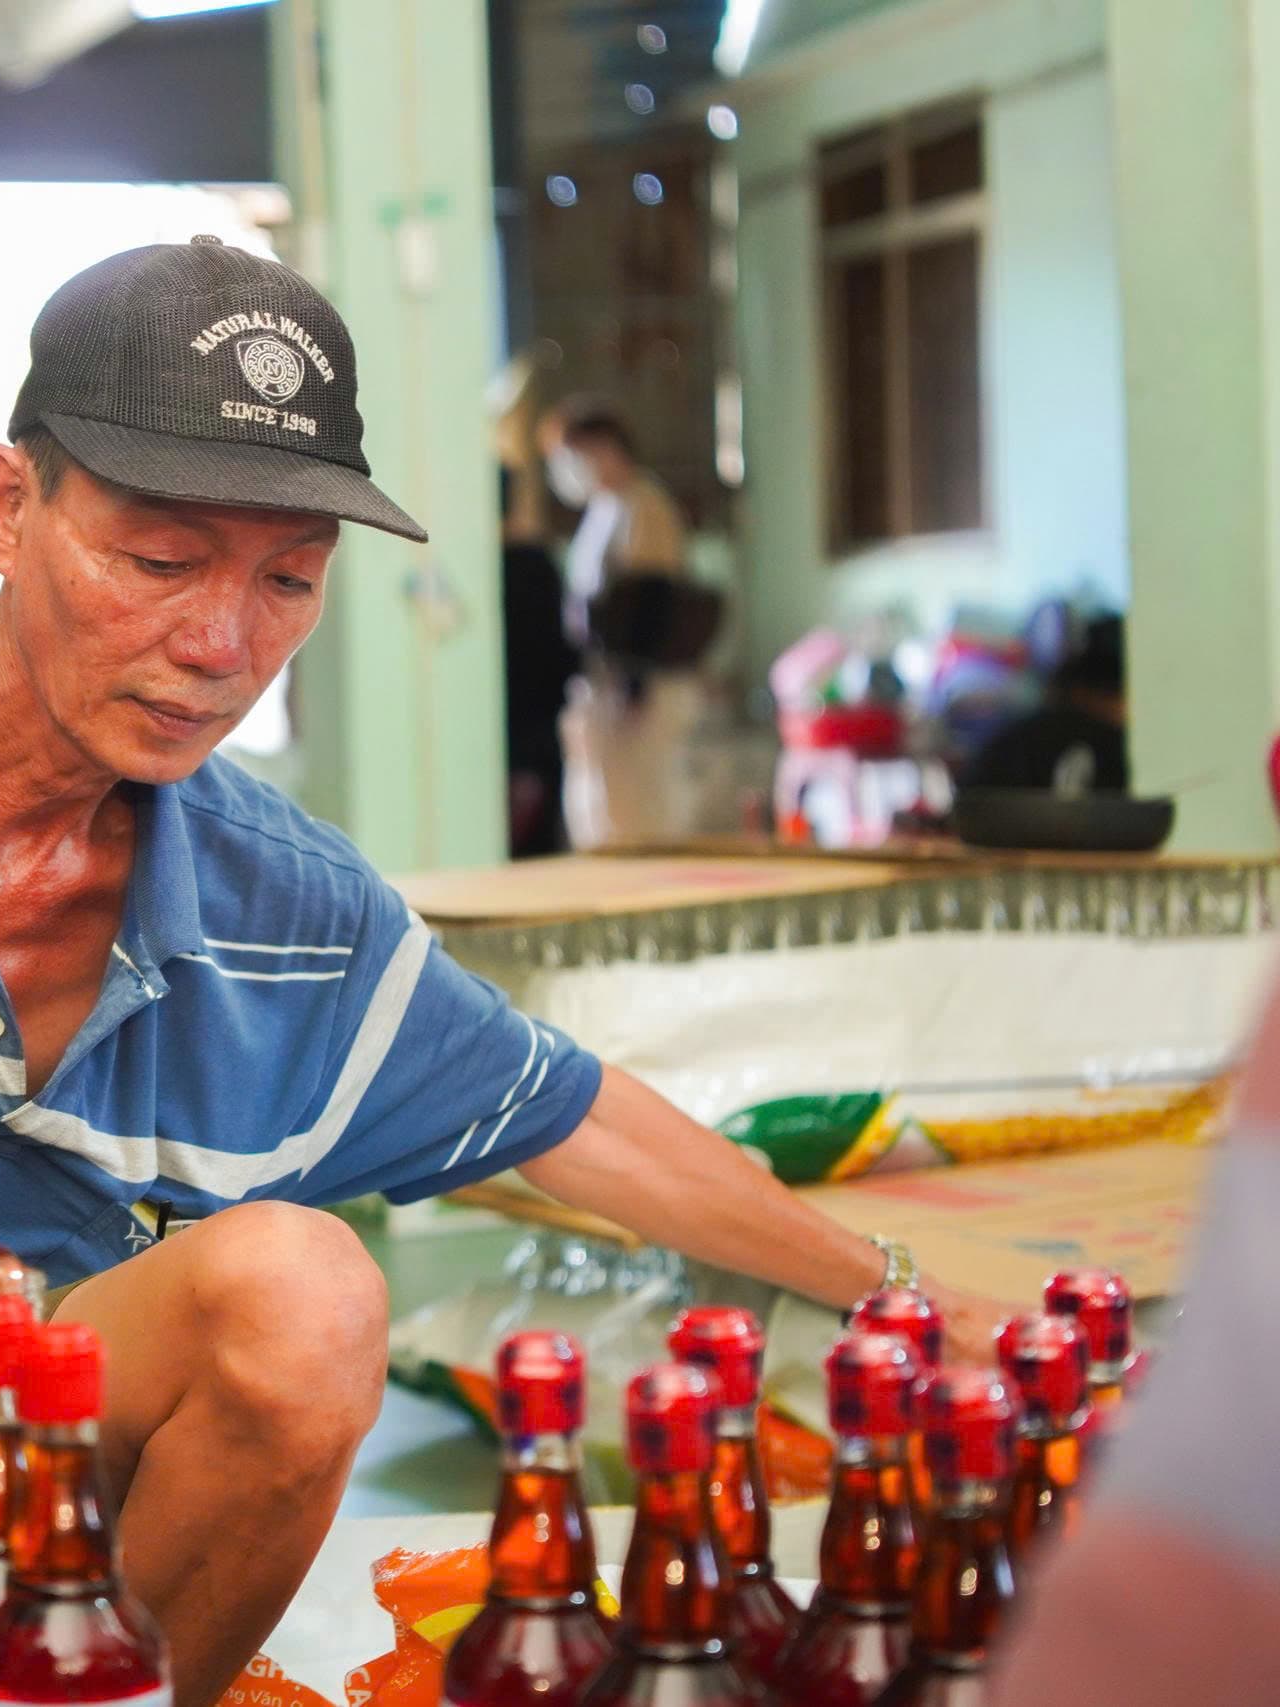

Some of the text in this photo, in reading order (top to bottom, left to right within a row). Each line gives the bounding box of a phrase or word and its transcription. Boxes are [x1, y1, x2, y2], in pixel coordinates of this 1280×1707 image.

[190, 311, 335, 384] NATURAL WALKER
[221, 400, 277, 424] SINCE
